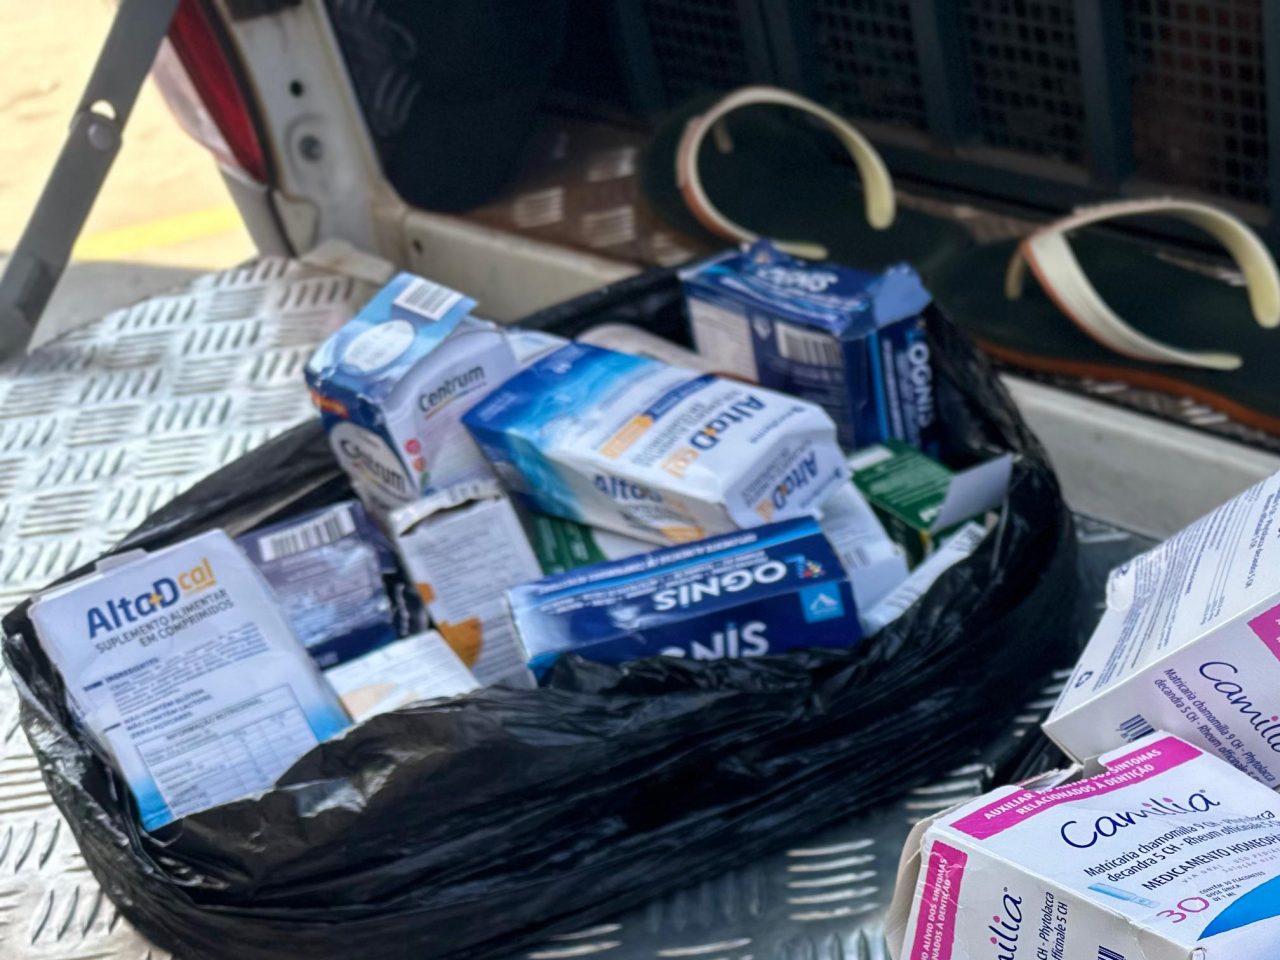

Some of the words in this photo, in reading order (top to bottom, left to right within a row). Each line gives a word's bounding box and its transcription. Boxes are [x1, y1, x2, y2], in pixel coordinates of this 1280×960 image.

[418, 366, 485, 413] Centrum
[96, 618, 168, 654] SUPLEMENTO
[170, 589, 228, 622] ALIMENTAR
[140, 631, 157, 648] EM
[157, 600, 235, 642] COMPRIMIDOS
[1154, 677, 1186, 708] decandra
[1197, 723, 1223, 747] Rheum
[1163, 667, 1197, 701] Matricaria
[1191, 696, 1231, 737] chamomilla
[1241, 748, 1276, 784] Phytolacca
[984, 791, 1035, 821] AUXILIAR
[1012, 781, 1096, 815] RELACIONADOS
[1103, 762, 1155, 787] DENTIÇÃO
[1060, 792, 1221, 850] Camilia
[1084, 851, 1139, 877] Matricaria
[1138, 825, 1198, 855] chamomilla
[1107, 857, 1157, 883] decandra
[1183, 830, 1221, 847] Rheum
[1142, 848, 1231, 891] MEDICAMENTO
[931, 857, 947, 903] SINTOMAS
[928, 902, 938, 920] DOS
[1037, 891, 1056, 942] Phytolacca
[1156, 895, 1210, 924] 30
[922, 920, 934, 951] ALÍVIO
